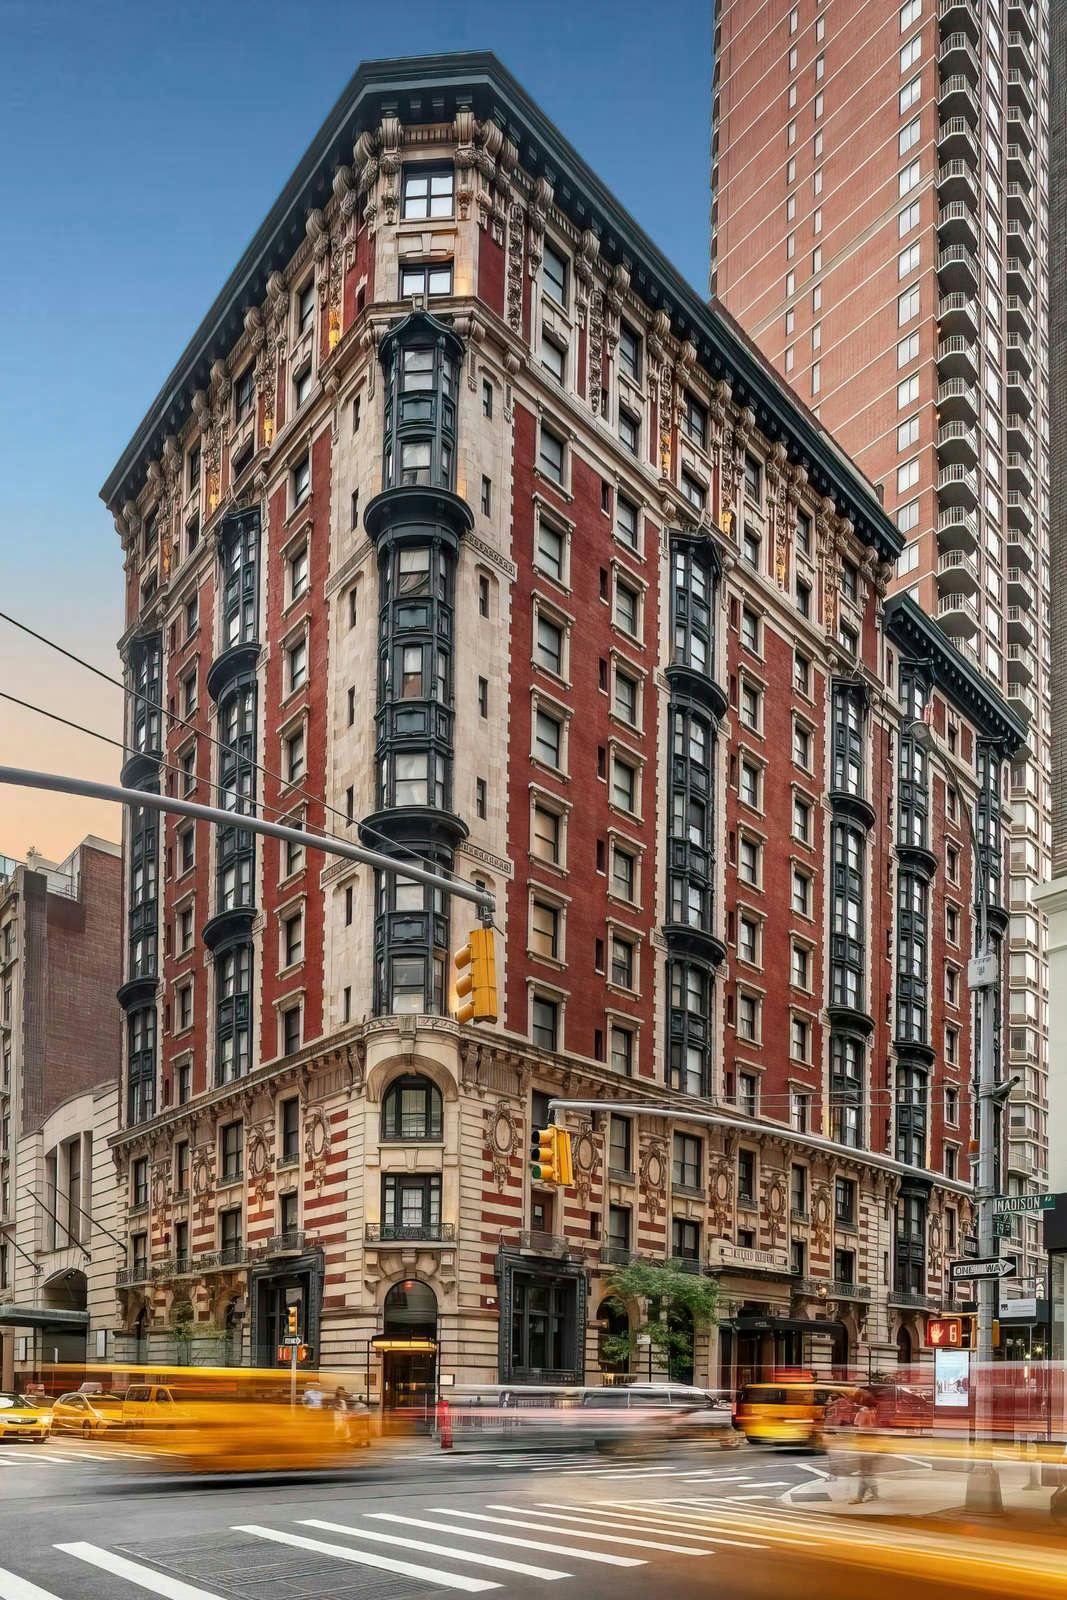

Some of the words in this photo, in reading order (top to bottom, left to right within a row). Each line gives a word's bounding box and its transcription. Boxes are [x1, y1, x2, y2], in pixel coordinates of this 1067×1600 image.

[997, 1197, 1040, 1213] MADISON
[955, 1264, 975, 1275] ONE
[985, 1262, 1007, 1273] WAY
